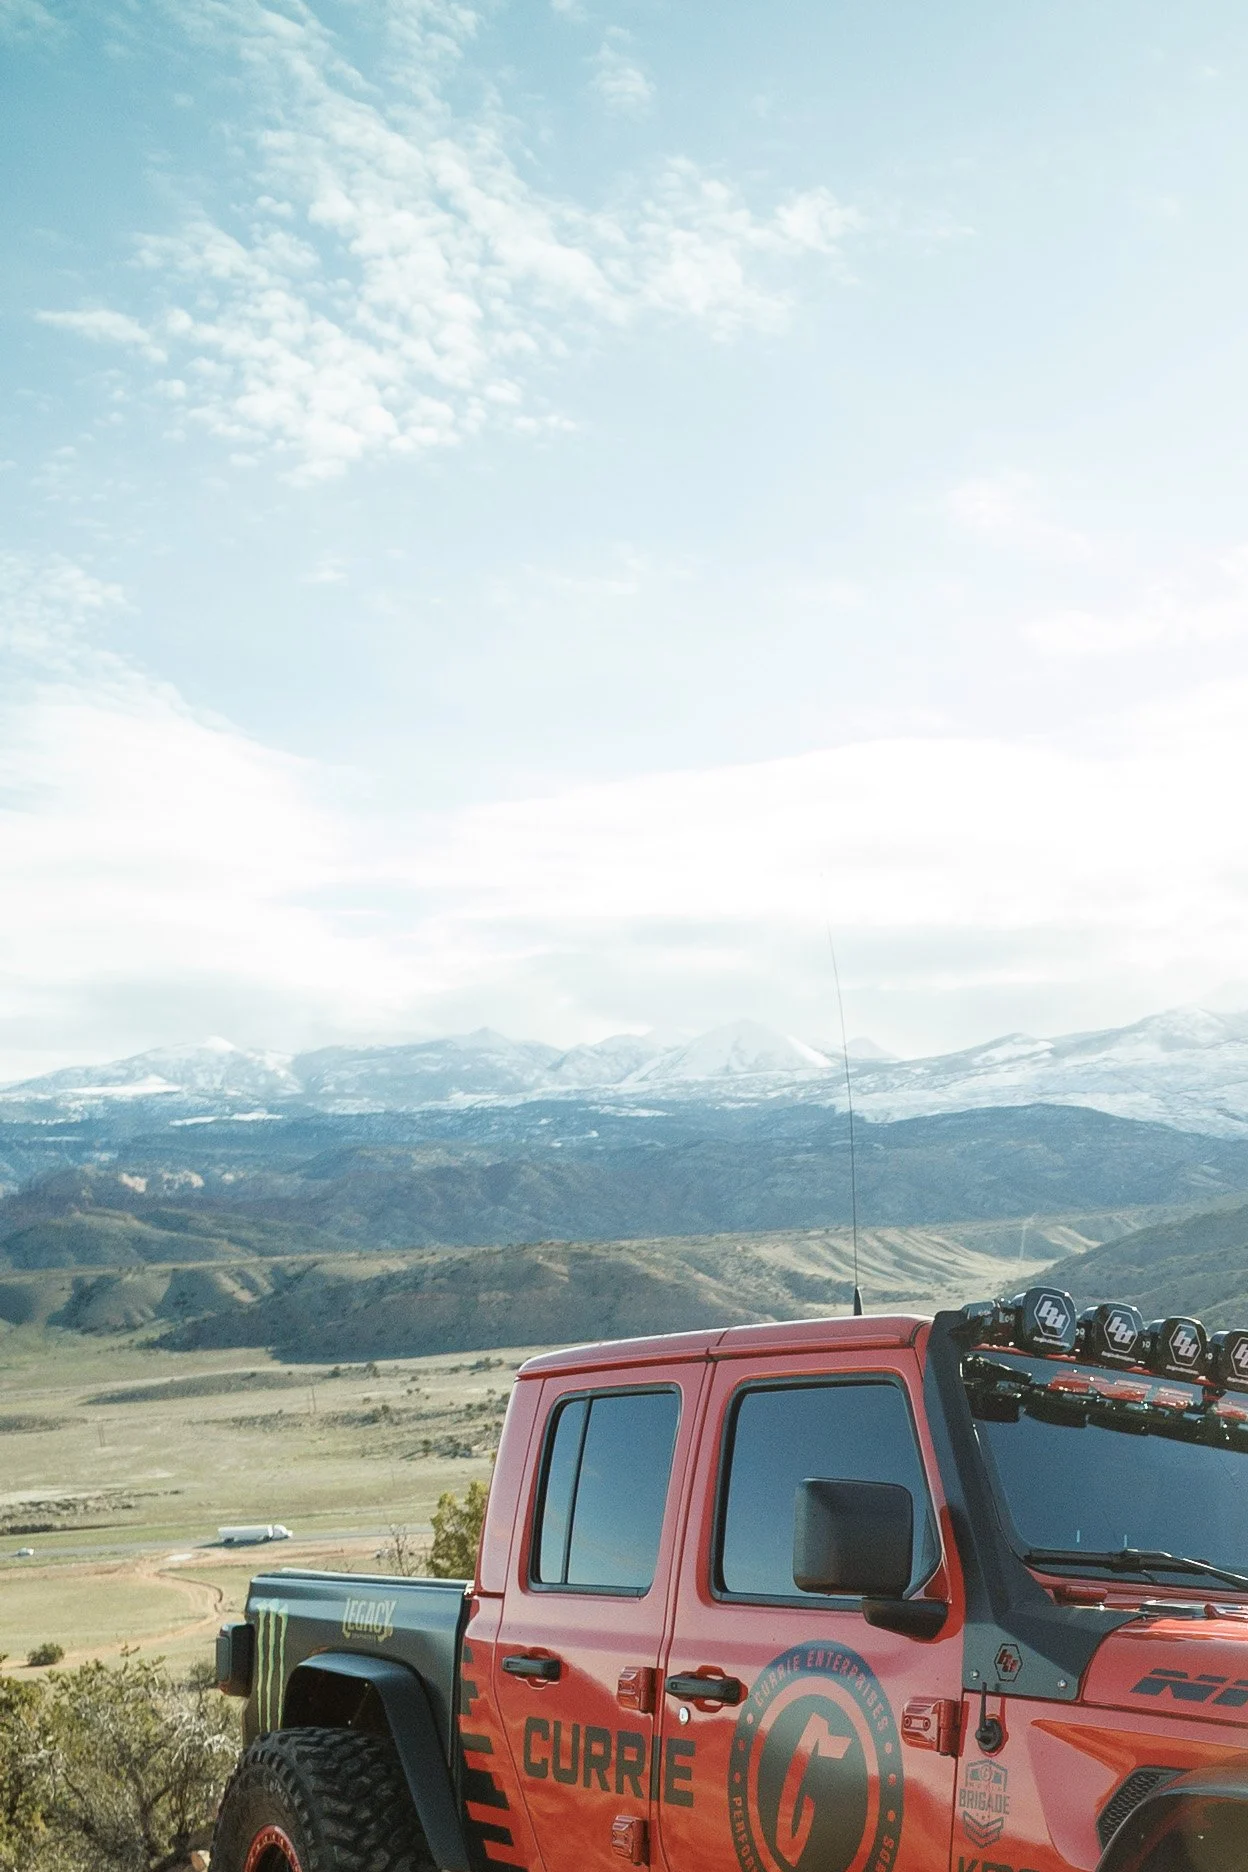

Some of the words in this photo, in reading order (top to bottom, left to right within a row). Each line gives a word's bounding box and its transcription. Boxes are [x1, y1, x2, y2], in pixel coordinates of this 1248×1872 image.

[342, 1598, 398, 1641] LEGACY
[754, 1654, 800, 1708] CURRIE
[806, 1649, 890, 1732] ENTERPRISES
[523, 1716, 697, 1808] CURRIE
[959, 1788, 1011, 1815] BRIGADE
